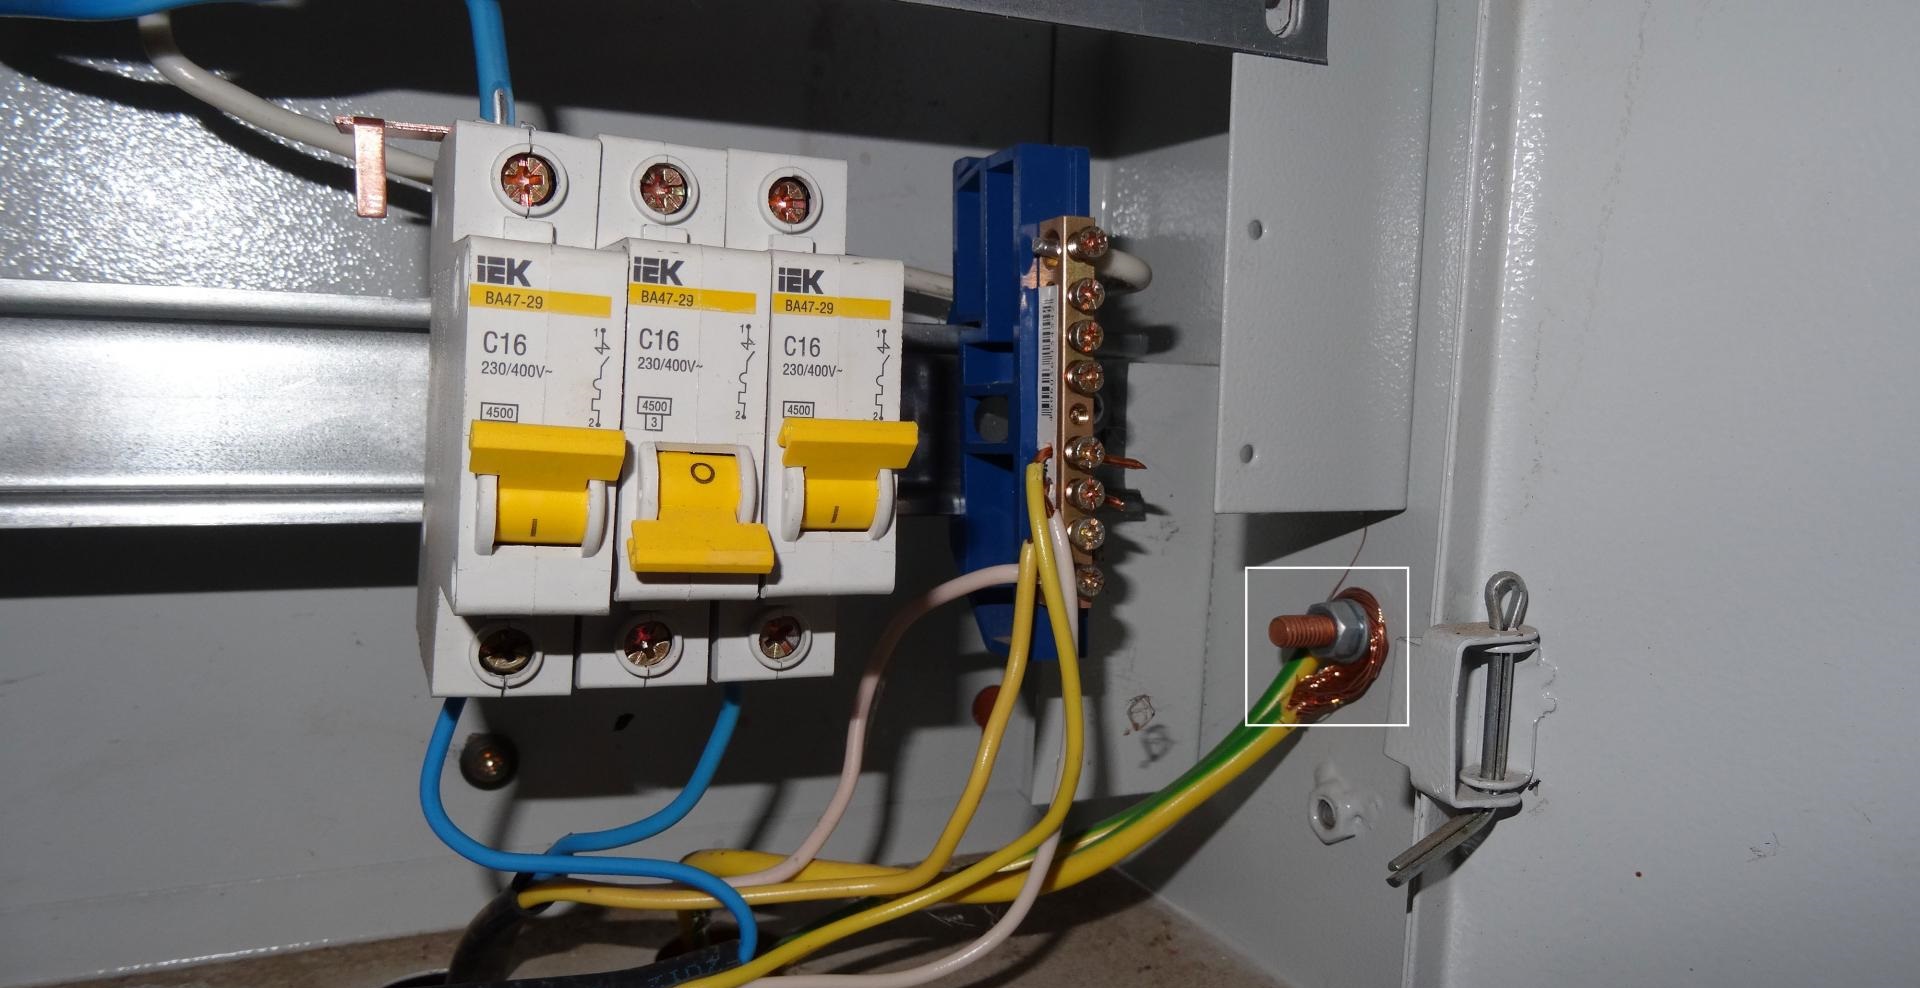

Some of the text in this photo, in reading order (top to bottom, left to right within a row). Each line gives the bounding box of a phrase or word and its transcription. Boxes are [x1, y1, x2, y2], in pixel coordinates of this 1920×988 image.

[485, 291, 543, 309] BA47-29
[641, 290, 694, 306] BA47-29
[785, 300, 834, 314] BA47-29
[483, 331, 527, 356] C16
[639, 328, 679, 351] C16
[784, 336, 821, 357] C16
[486, 406, 514, 419] 4500
[642, 401, 667, 412] 4500
[787, 405, 810, 415] 4500
[651, 419, 657, 428] 3
